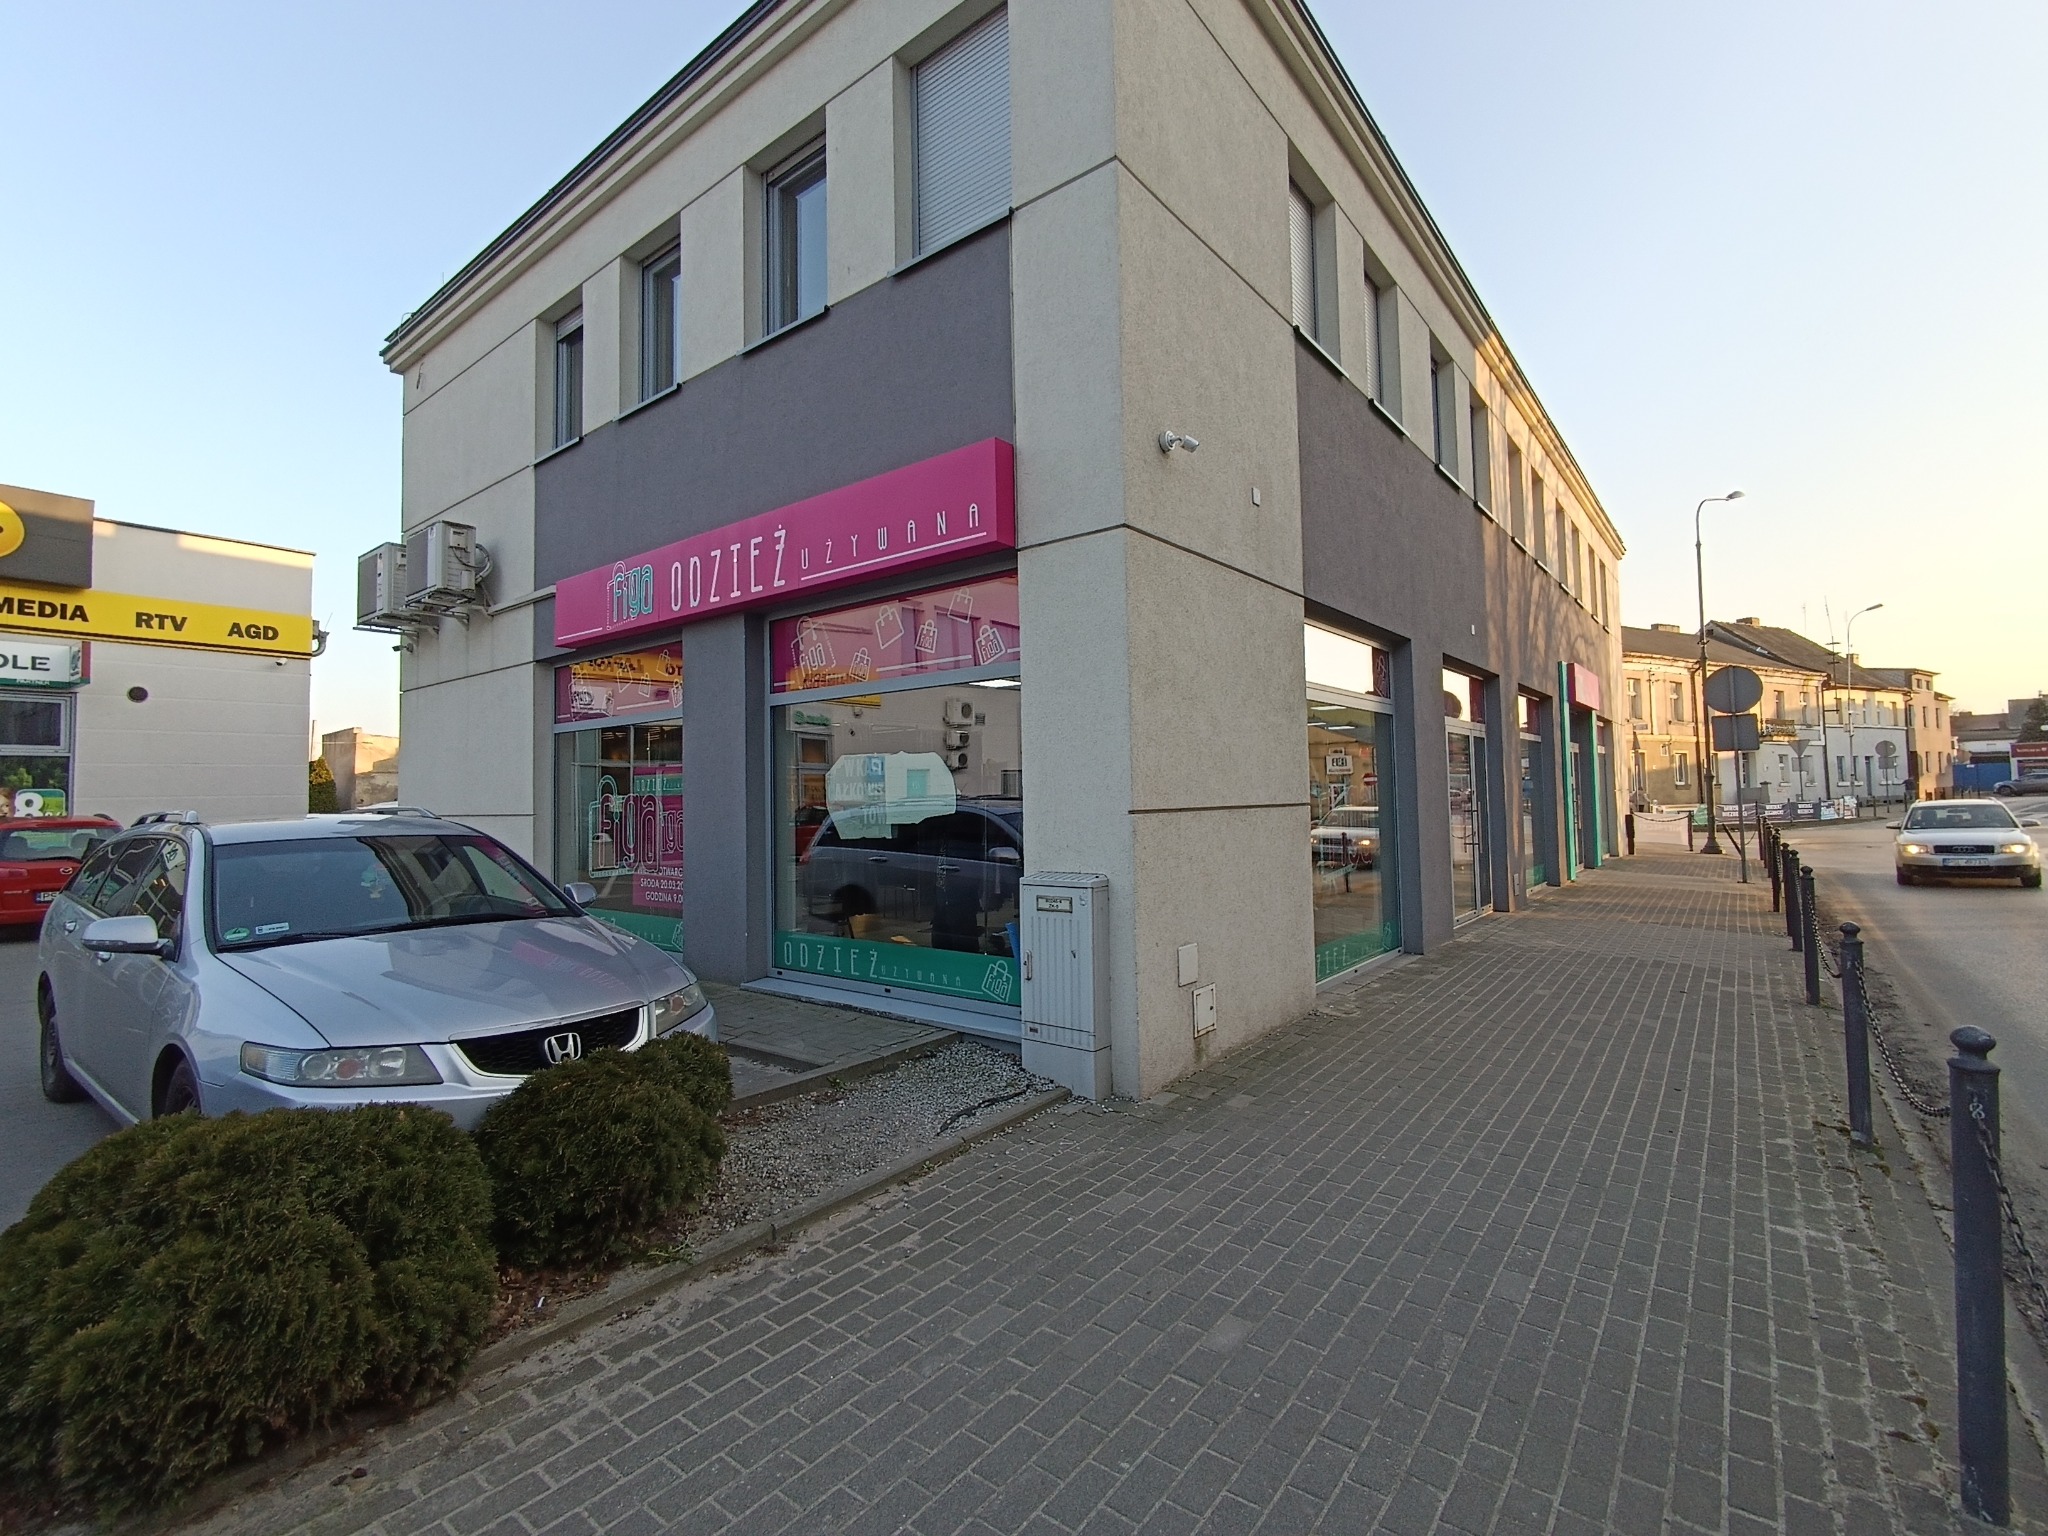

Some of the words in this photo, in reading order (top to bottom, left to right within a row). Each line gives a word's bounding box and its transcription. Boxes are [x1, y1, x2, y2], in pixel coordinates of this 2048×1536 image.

[671, 524, 786, 611] ODZIEŻ
[801, 502, 979, 569] UŻYWANA
[0, 596, 89, 623] MEDIA
[135, 611, 188, 632] RTV
[227, 622, 280, 641] AGD
[784, 941, 878, 978] ODZIEŻ
